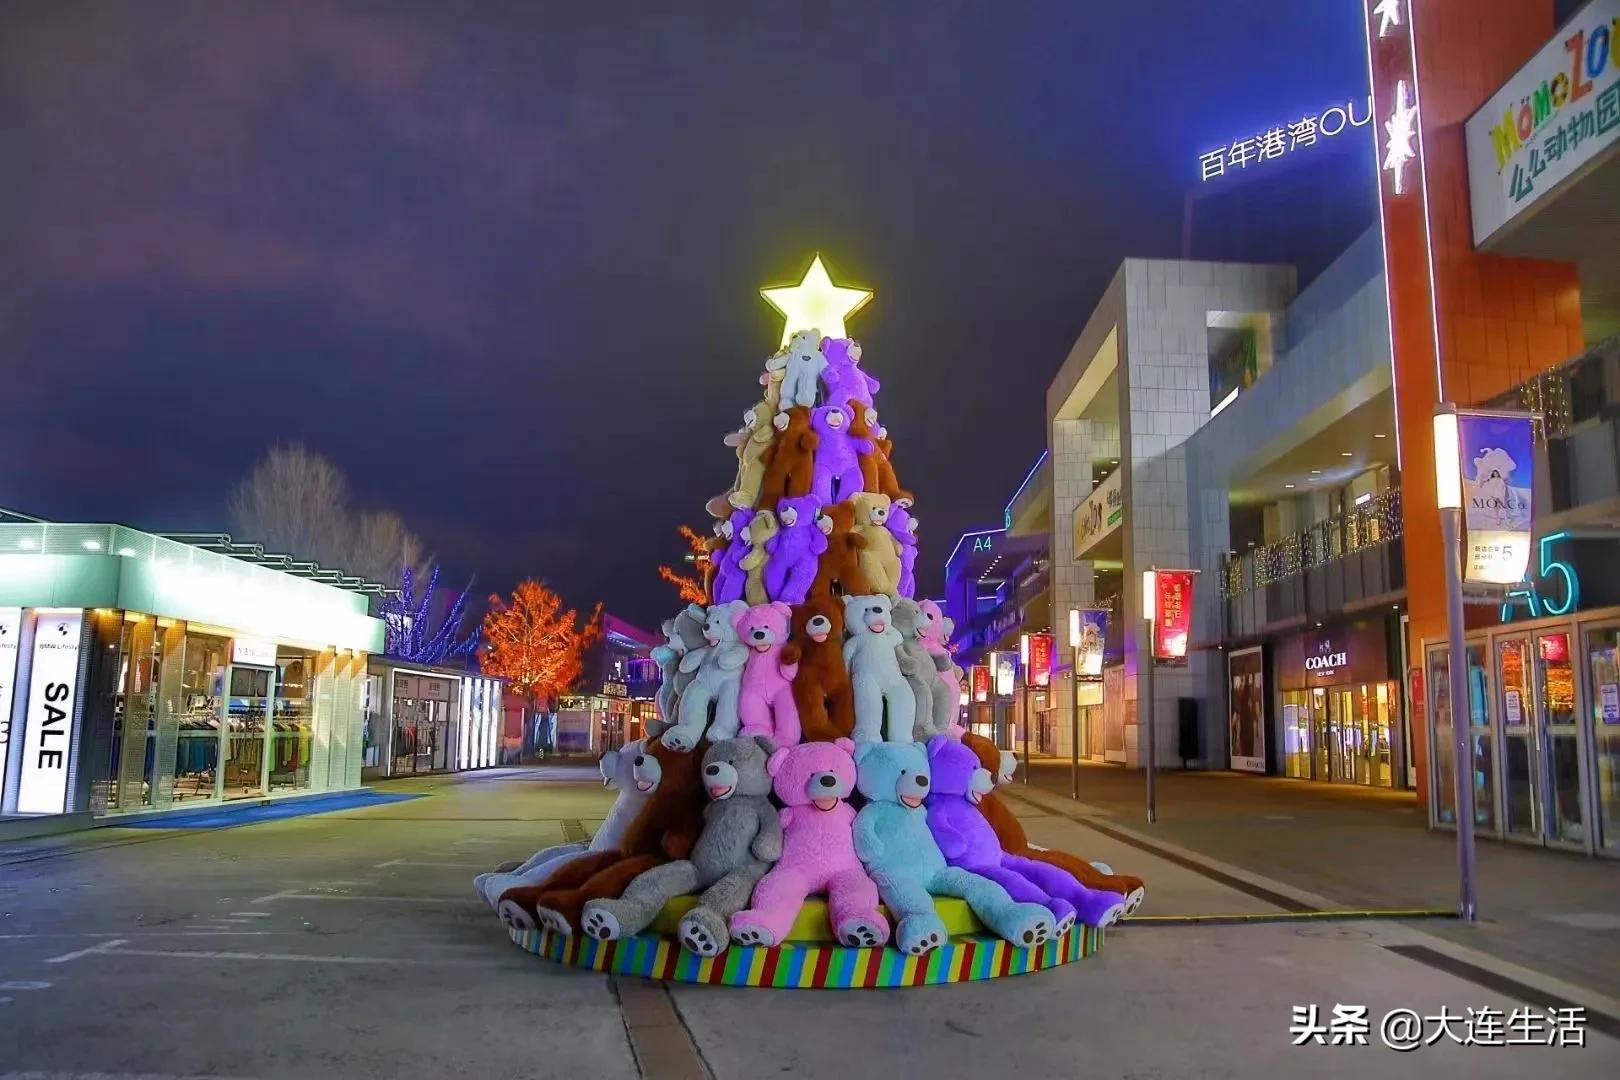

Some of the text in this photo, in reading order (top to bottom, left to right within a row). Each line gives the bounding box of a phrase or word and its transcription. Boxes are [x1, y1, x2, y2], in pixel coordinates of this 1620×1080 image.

[973, 536, 992, 552] A4
[1305, 652, 1347, 670] COACH
[37, 682, 69, 770] SALE
